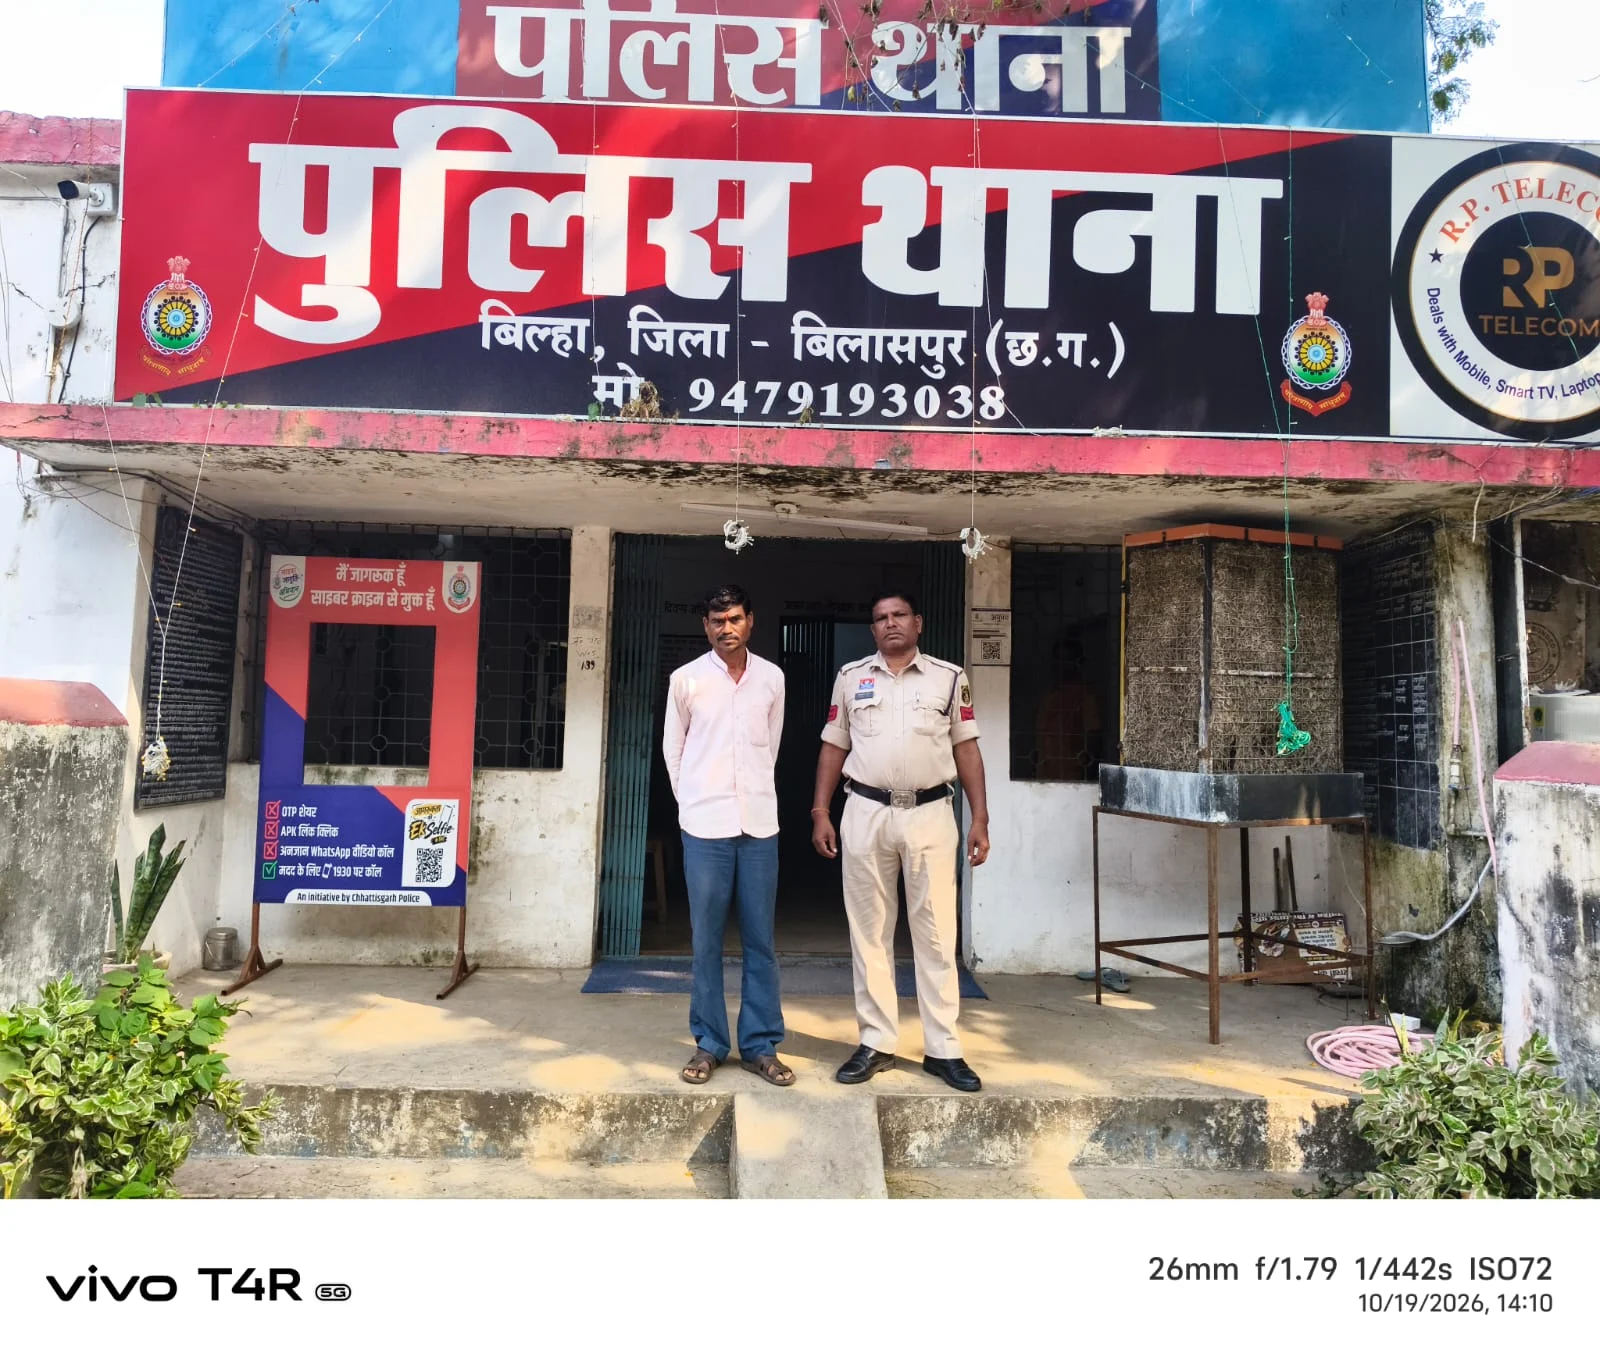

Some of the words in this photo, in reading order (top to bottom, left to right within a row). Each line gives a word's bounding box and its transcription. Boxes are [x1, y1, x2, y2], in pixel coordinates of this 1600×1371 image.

[870, 21, 1132, 113] थाना
[248, 105, 812, 344] पुलिस
[862, 165, 1283, 315] थाना
[1440, 198, 1490, 244] R.P.
[1502, 246, 1575, 309] RP
[479, 299, 605, 363] बिल्हा,
[627, 305, 730, 358] जिला
[790, 310, 967, 380] बिलासपुर
[985, 318, 1125, 380] (छ.ग.)
[1427, 287, 1444, 325] Deals
[1437, 326, 1456, 353] with
[1453, 350, 1492, 390] Mobile,
[1496, 378, 1535, 400] Smart
[1539, 386, 1559, 401] TV,
[689, 378, 1006, 421] 9479193038
[336, 563, 349, 582] मैं
[350, 567, 394, 584] जागरूक
[397, 561, 407, 587] हूँ
[310, 589, 349, 607] साइबर
[351, 590, 385, 607] क्राइम
[387, 588, 399, 607] से
[400, 592, 424, 612] मुक्त
[424, 586, 436, 611] हूँ
[281, 805, 297, 818] OTP
[298, 804, 317, 818] शेयर
[280, 825, 297, 837] APK
[316, 824, 340, 838] क्लिक
[424, 821, 453, 839] Selfie
[280, 845, 310, 857] अनजान
[310, 845, 351, 860] WhatsApp
[352, 844, 376, 858] वीडियो
[376, 845, 395, 858] कॉल
[278, 865, 297, 877] मदद
[296, 862, 305, 877] के
[305, 862, 322, 877] लिए
[333, 865, 352, 877] 1930
[353, 866, 364, 878] पर
[364, 864, 383, 878] कॉल
[297, 892, 307, 901] An
[308, 893, 340, 902] initiative
[341, 893, 351, 904] by
[351, 893, 397, 904] Chhattisgarh
[399, 894, 420, 903] Police
